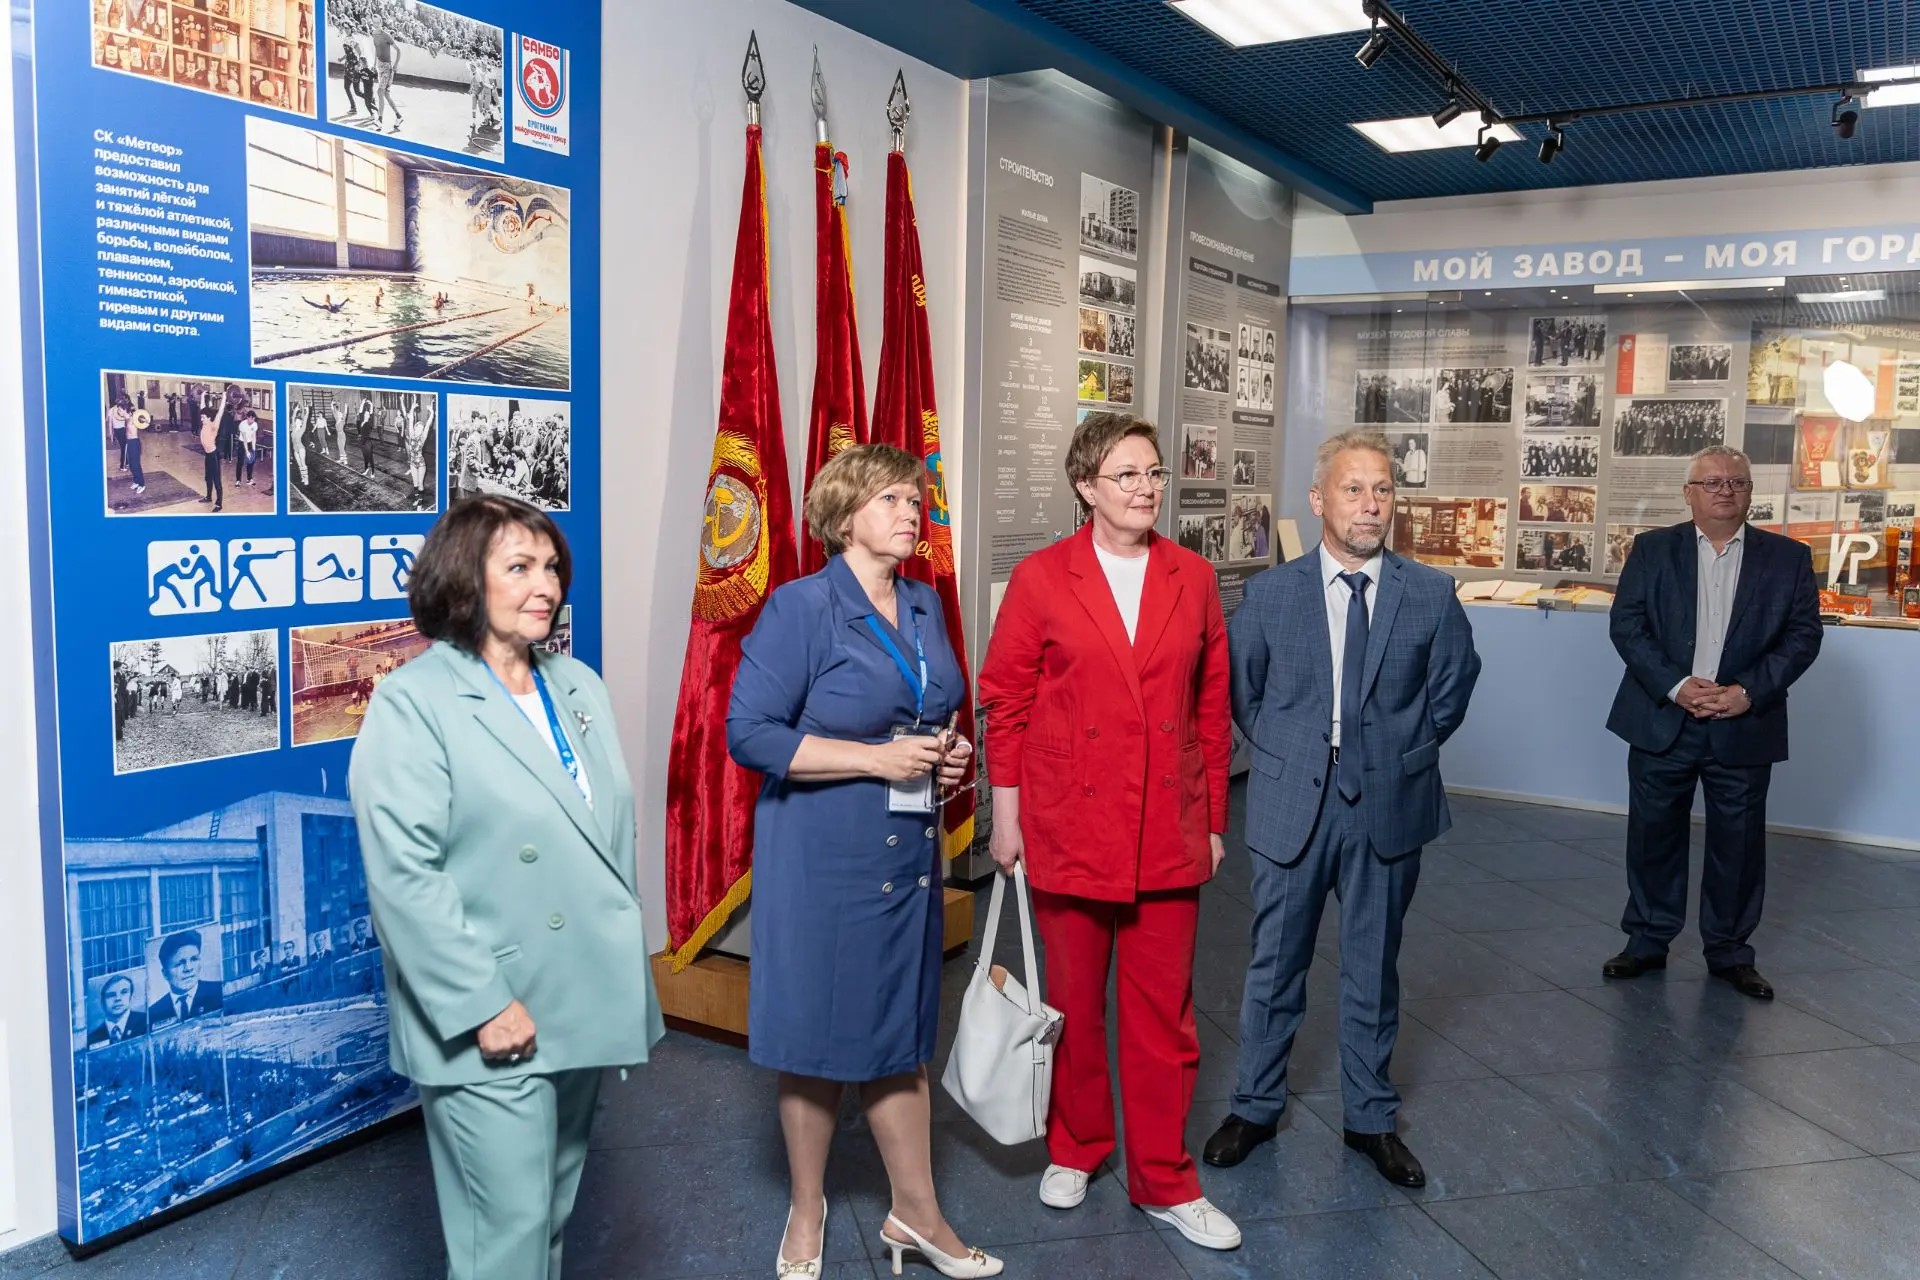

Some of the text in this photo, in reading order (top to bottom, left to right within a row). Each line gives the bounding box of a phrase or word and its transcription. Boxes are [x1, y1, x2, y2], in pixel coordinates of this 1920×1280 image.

[522, 37, 560, 60] САМБО
[528, 119, 558, 134] ПРОГРАММА
[93, 128, 184, 157] СК «Метеор»
[94, 147, 181, 173] предоставил
[999, 157, 1055, 188] СТРОИТЕЛЬСТВО
[95, 165, 210, 195] возможность для
[95, 181, 197, 209] занятий лёгкой
[95, 199, 234, 232] и тяжёлой атлетикой,
[96, 215, 229, 246] различными видами
[96, 231, 234, 263] борьбы, волейболом,
[96, 250, 174, 271] плаванием,
[1413, 251, 1493, 283] МОЙ
[1512, 248, 1645, 279] ЗАВОД
[1704, 240, 1797, 270] МОЯ
[97, 267, 238, 295] теннисом, аэробикой,
[98, 283, 188, 305] гимнастикой,
[99, 300, 225, 324] гиревым и другими
[99, 317, 200, 337] видами спорта.
[1389, 328, 1436, 339] ТРУДОВОЙ
[1437, 327, 1471, 338] СЛАВЫ
